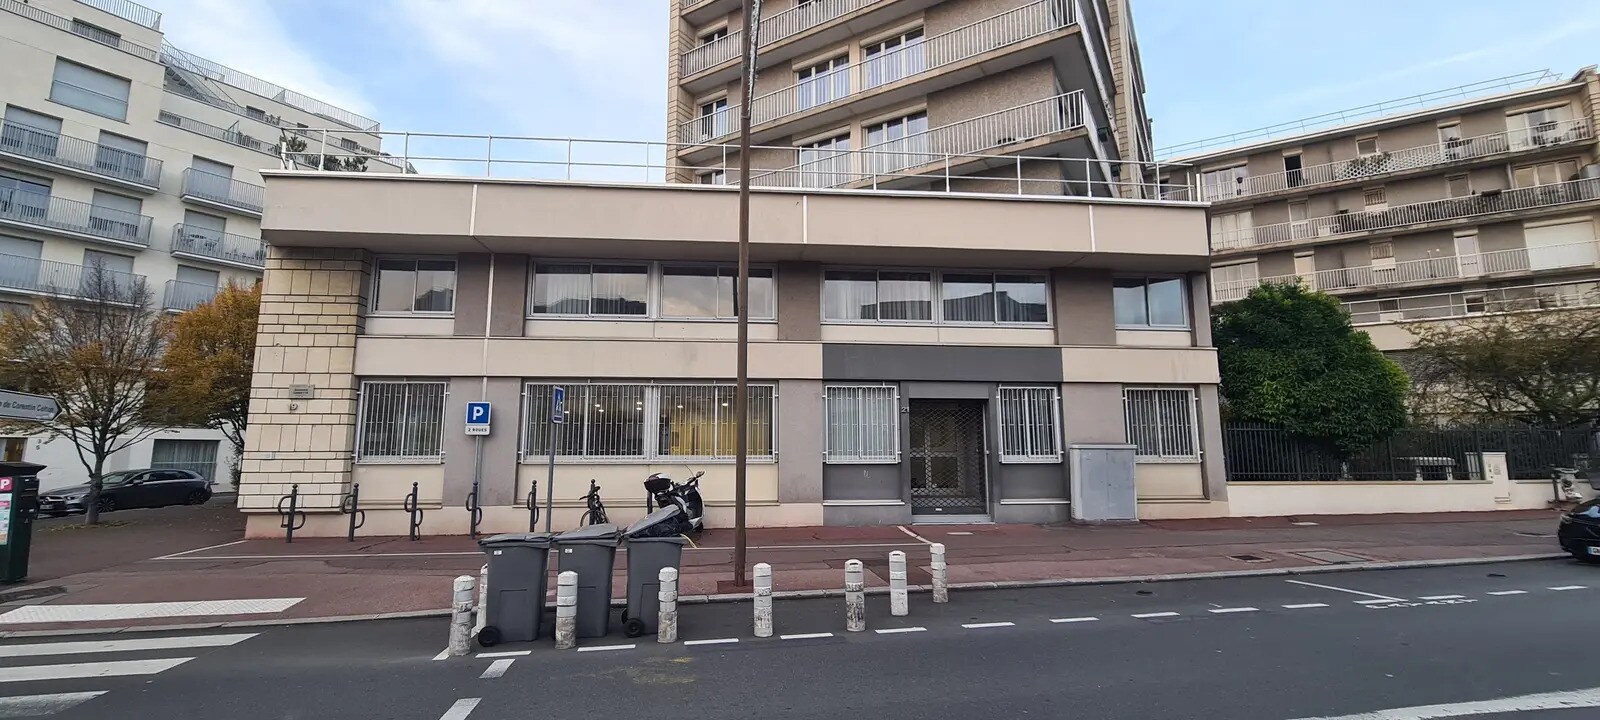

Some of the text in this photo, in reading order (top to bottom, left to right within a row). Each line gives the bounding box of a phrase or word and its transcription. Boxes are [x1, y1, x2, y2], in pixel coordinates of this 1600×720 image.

[290, 402, 298, 411] 9
[473, 406, 484, 421] P
[0, 479, 10, 490] P
